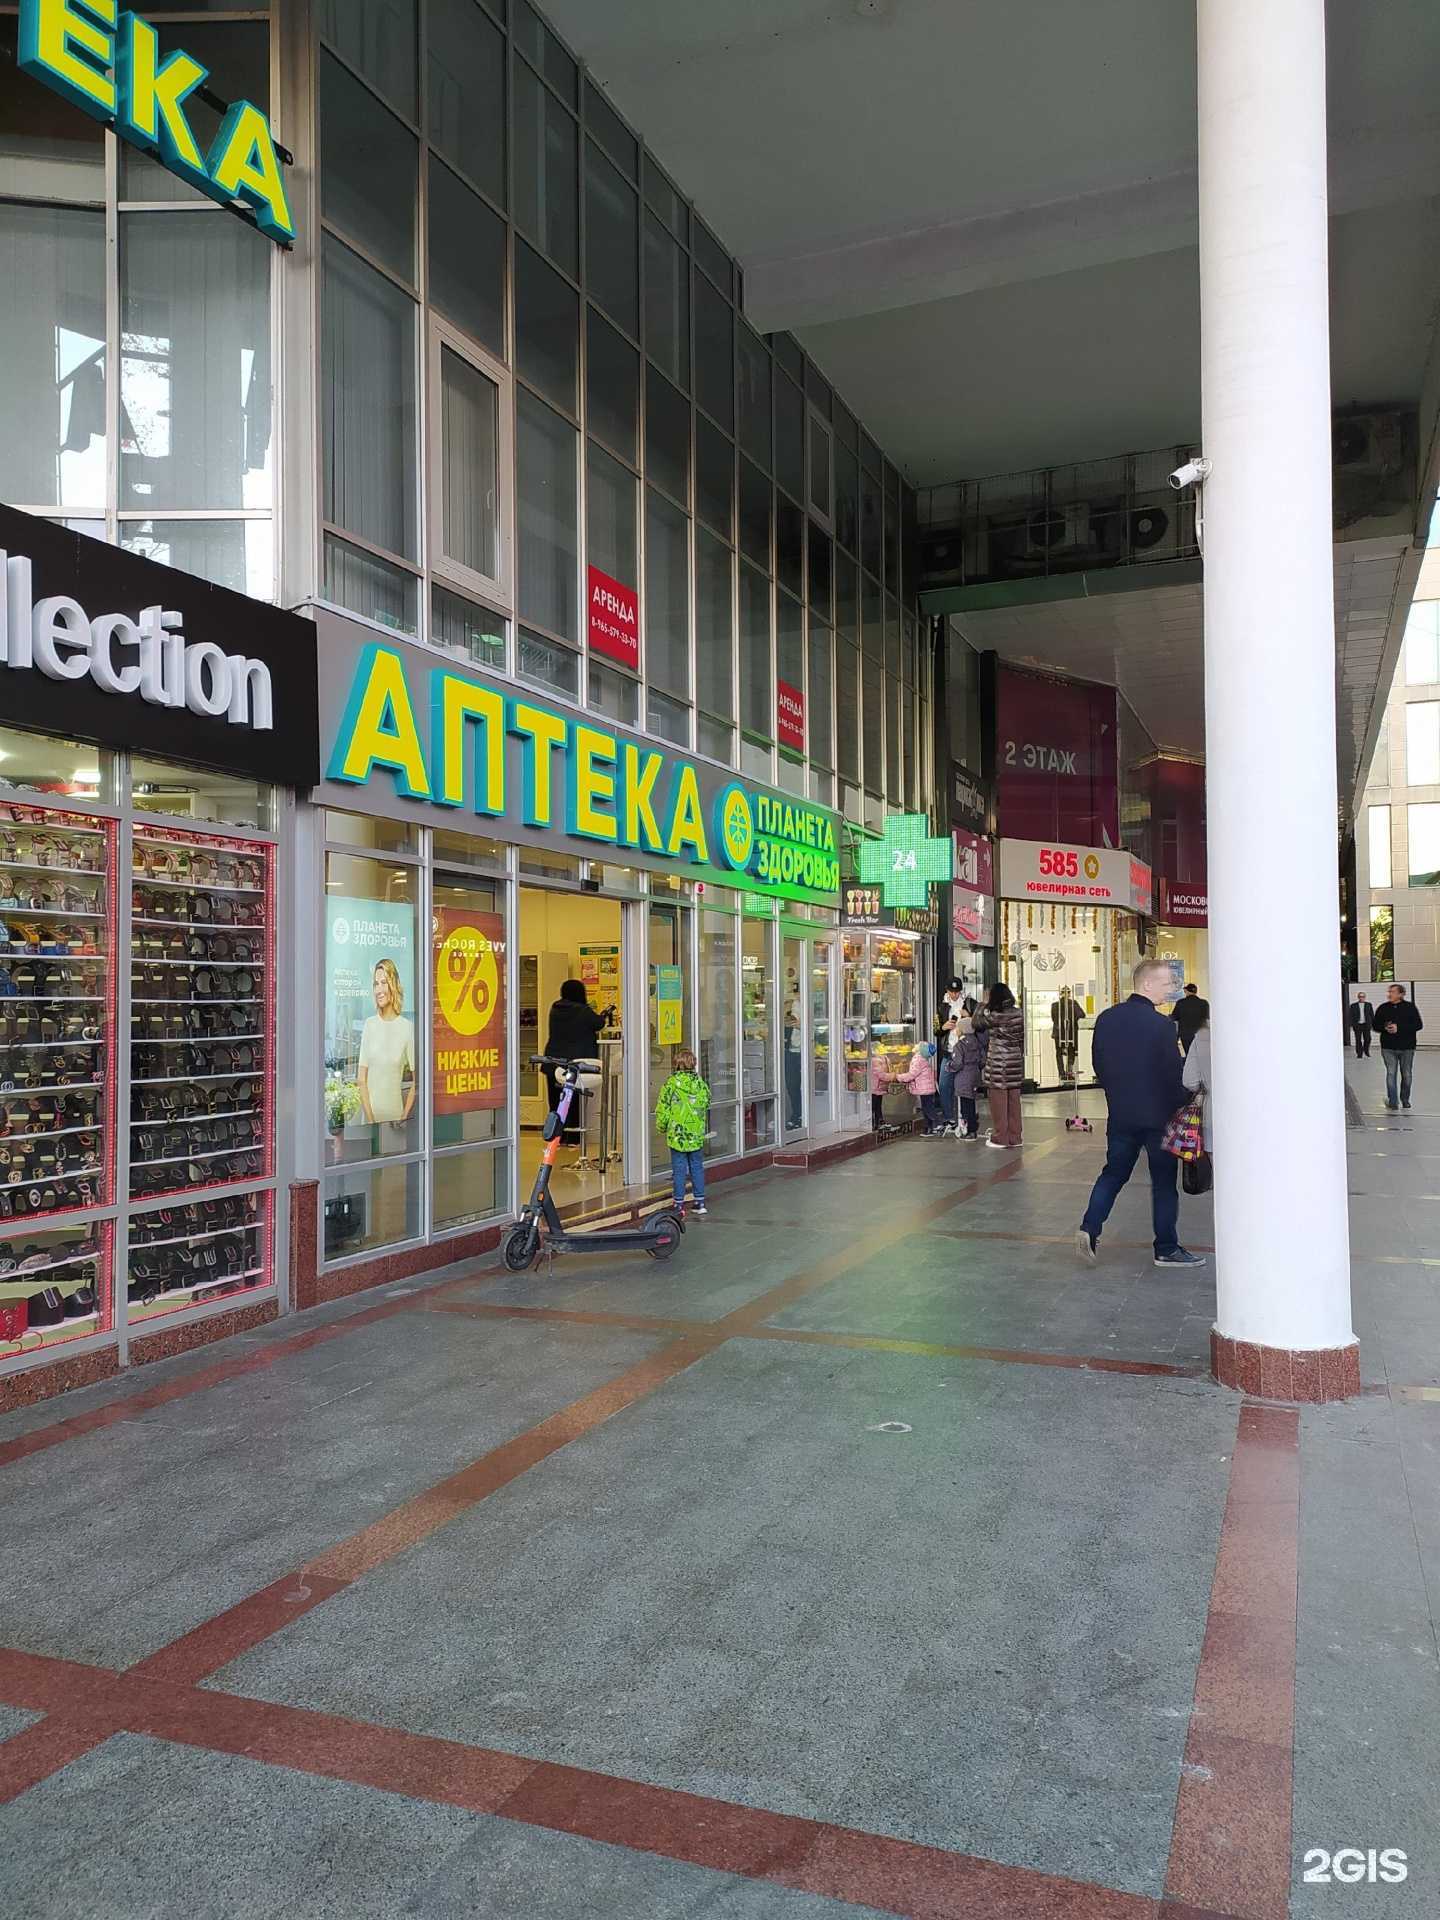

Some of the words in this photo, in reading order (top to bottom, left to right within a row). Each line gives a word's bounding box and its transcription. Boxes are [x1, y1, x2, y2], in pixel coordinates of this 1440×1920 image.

[593, 586, 635, 624] АРЕНДА
[779, 693, 803, 718] АРЕНДА
[327, 643, 710, 864] АПТЕКА
[1005, 741, 1016, 765] 2
[1023, 744, 1077, 775] ЭТАЖ
[757, 796, 835, 853] ПЛАНЕТА
[757, 840, 840, 892] ЗДОРОВЬЯ
[1039, 849, 1079, 878] 585
[1026, 881, 1086, 896] ювелирная
[1089, 886, 1111, 897] сеть
[1173, 894, 1208, 906] МОСКОВ
[353, 920, 400, 936] ПЛАНЕТА
[847, 916, 865, 924] Fresh
[353, 933, 407, 948] ЗДОРОВЬЯ
[437, 1048, 499, 1071] НИЗКИЕ
[446, 1071, 492, 1097] ЦЕНЫ
